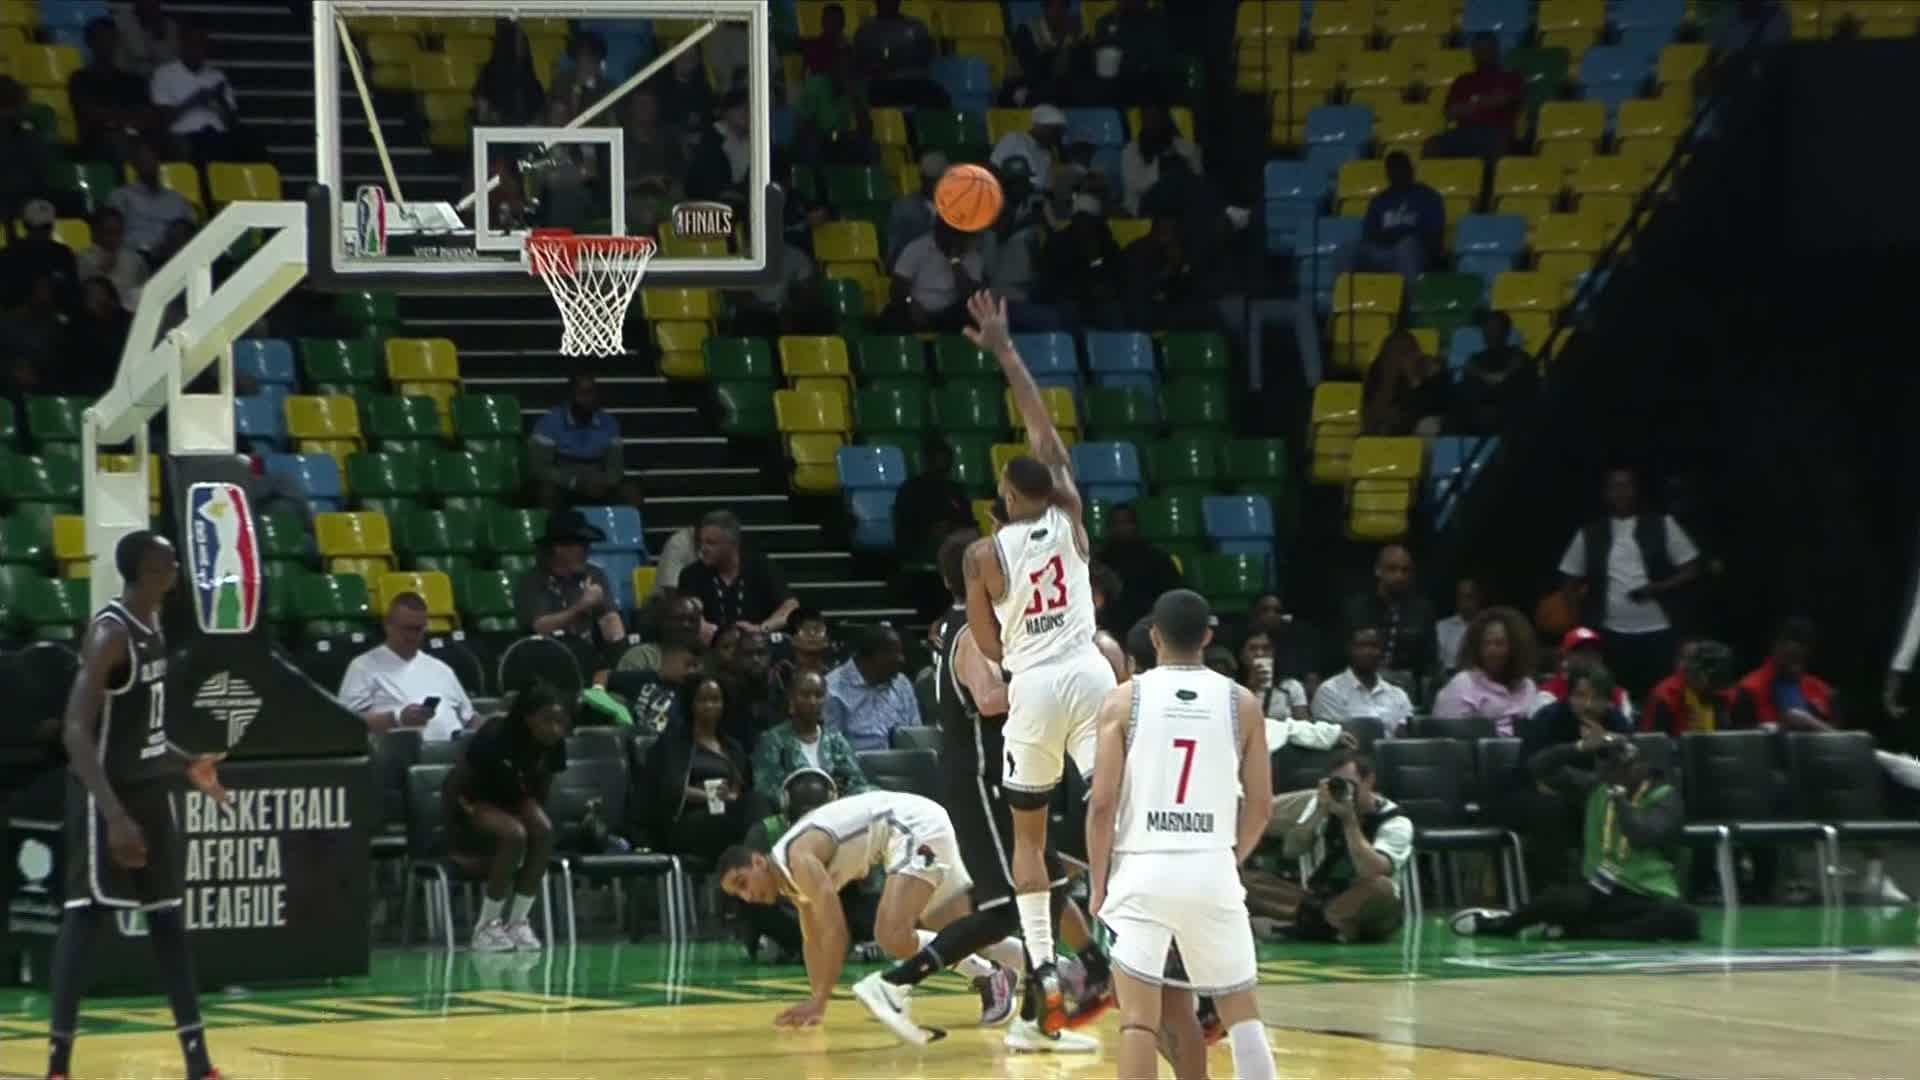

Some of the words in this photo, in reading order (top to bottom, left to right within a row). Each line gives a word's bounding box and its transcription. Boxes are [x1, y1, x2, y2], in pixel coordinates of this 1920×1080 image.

[685, 210, 732, 233] FINALS
[1173, 738, 1197, 804] 7
[185, 786, 351, 832] BASKETBALL
[185, 837, 282, 880] AFRICA
[185, 884, 287, 929] LEAGUE
